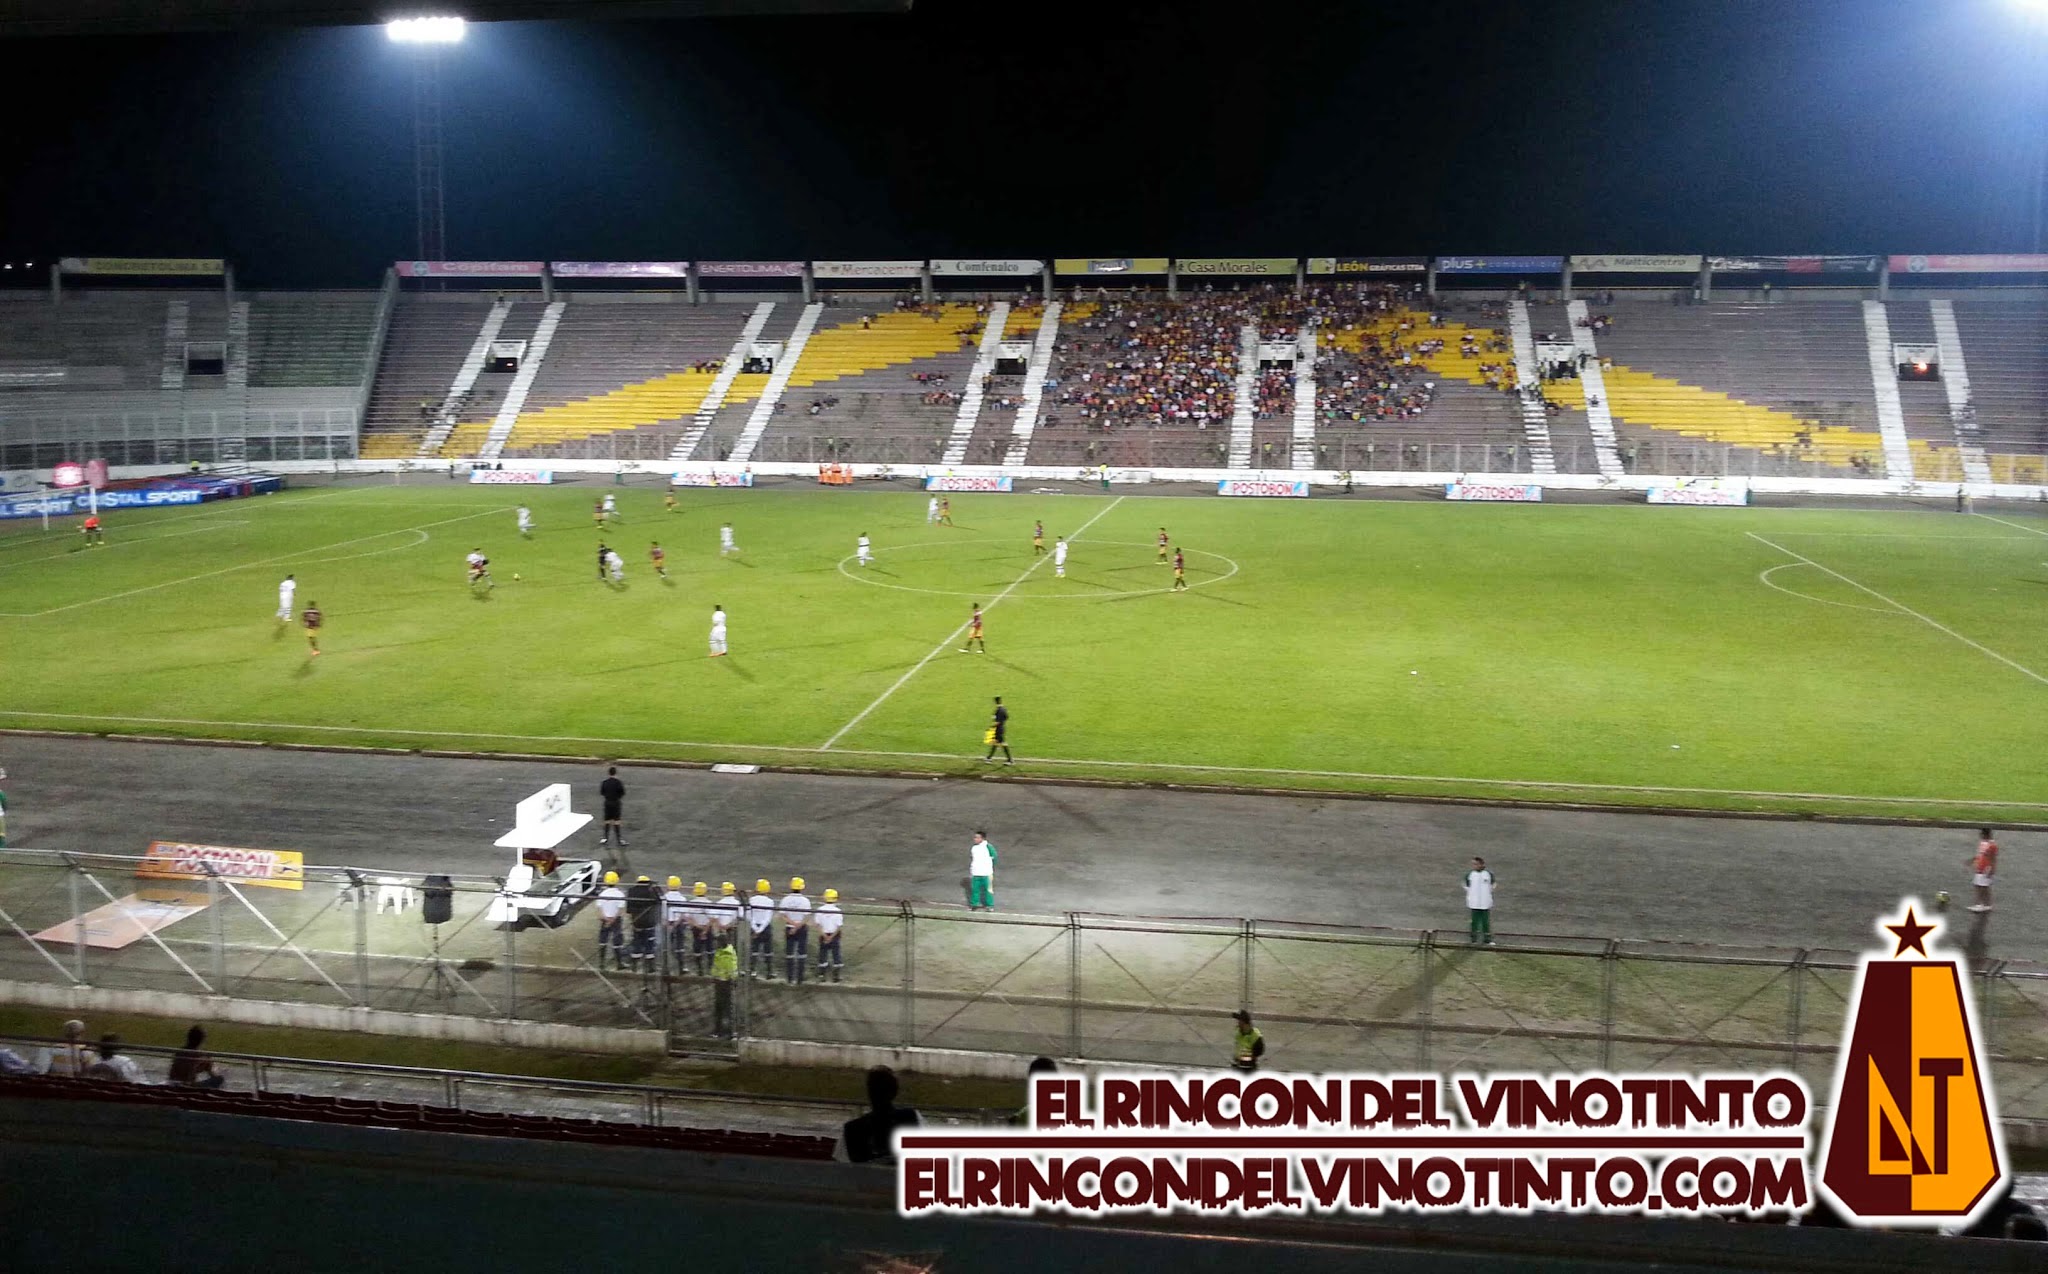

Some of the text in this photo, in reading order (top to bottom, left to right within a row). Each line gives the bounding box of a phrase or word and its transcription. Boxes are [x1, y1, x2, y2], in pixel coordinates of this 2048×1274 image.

[702, 264, 783, 273] ENERTOLIMA
[956, 261, 1019, 272] Comfenalco
[1188, 261, 1268, 273] Casa Morales
[1337, 260, 1368, 272] LEÓN
[940, 477, 998, 491] POSTOBON
[1232, 482, 1294, 496] POSTOBON
[147, 490, 200, 503] SPORT
[1461, 486, 1525, 499] POSTOBON
